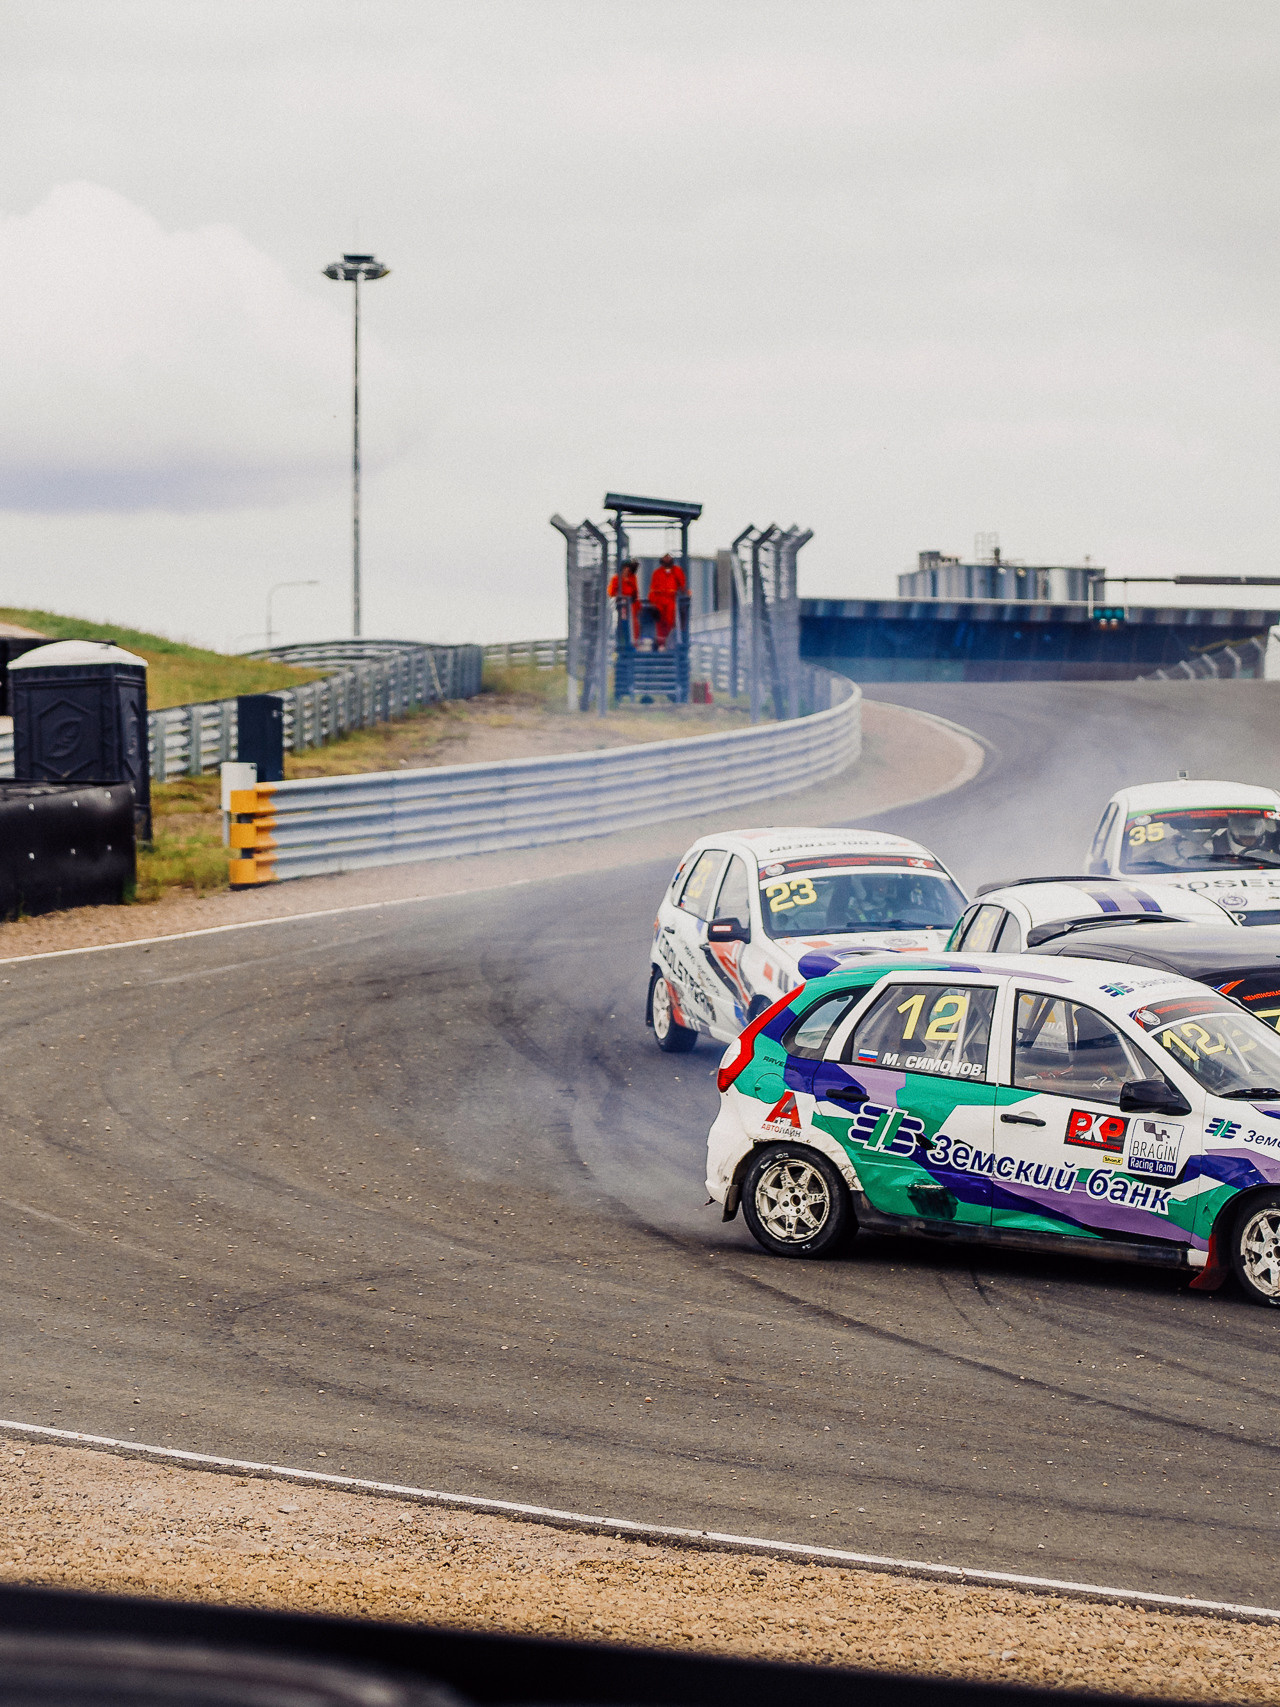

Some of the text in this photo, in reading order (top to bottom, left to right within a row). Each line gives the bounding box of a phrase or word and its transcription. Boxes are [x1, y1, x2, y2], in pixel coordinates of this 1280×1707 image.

[1128, 821, 1165, 847] 35
[765, 878, 818, 913] 23
[896, 994, 968, 1041] 12
[1162, 1022, 1226, 1062] 12
[882, 1052, 983, 1076] М. СИМОНОВ
[930, 1135, 1172, 1211] Земский банк
[1130, 1158, 1174, 1174] Racing Team
